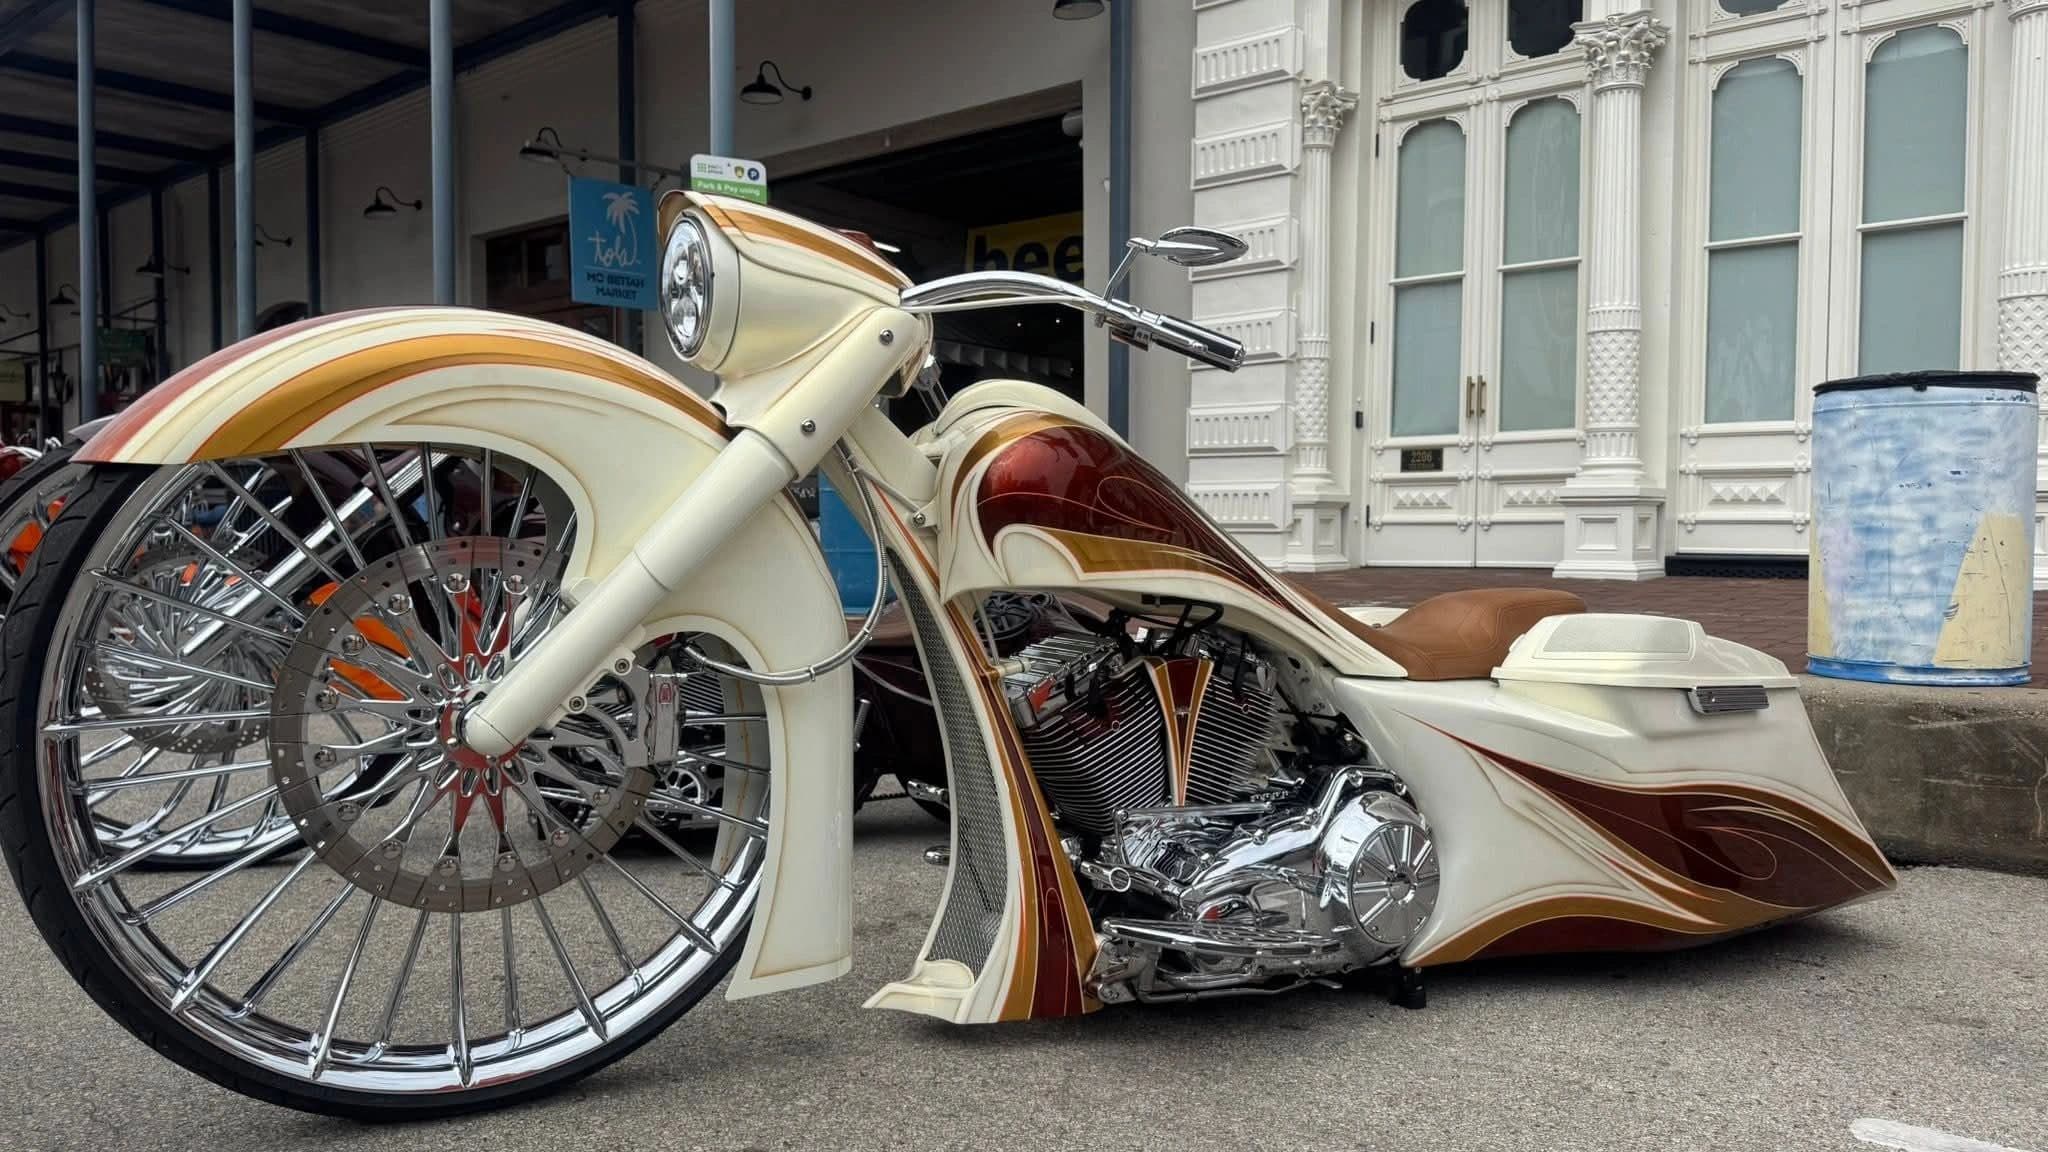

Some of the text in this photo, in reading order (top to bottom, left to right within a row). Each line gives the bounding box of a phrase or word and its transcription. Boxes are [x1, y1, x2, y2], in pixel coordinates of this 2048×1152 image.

[697, 180, 761, 197] Park & Pay using
[586, 271, 605, 284] MO
[595, 286, 637, 301] MARKET
